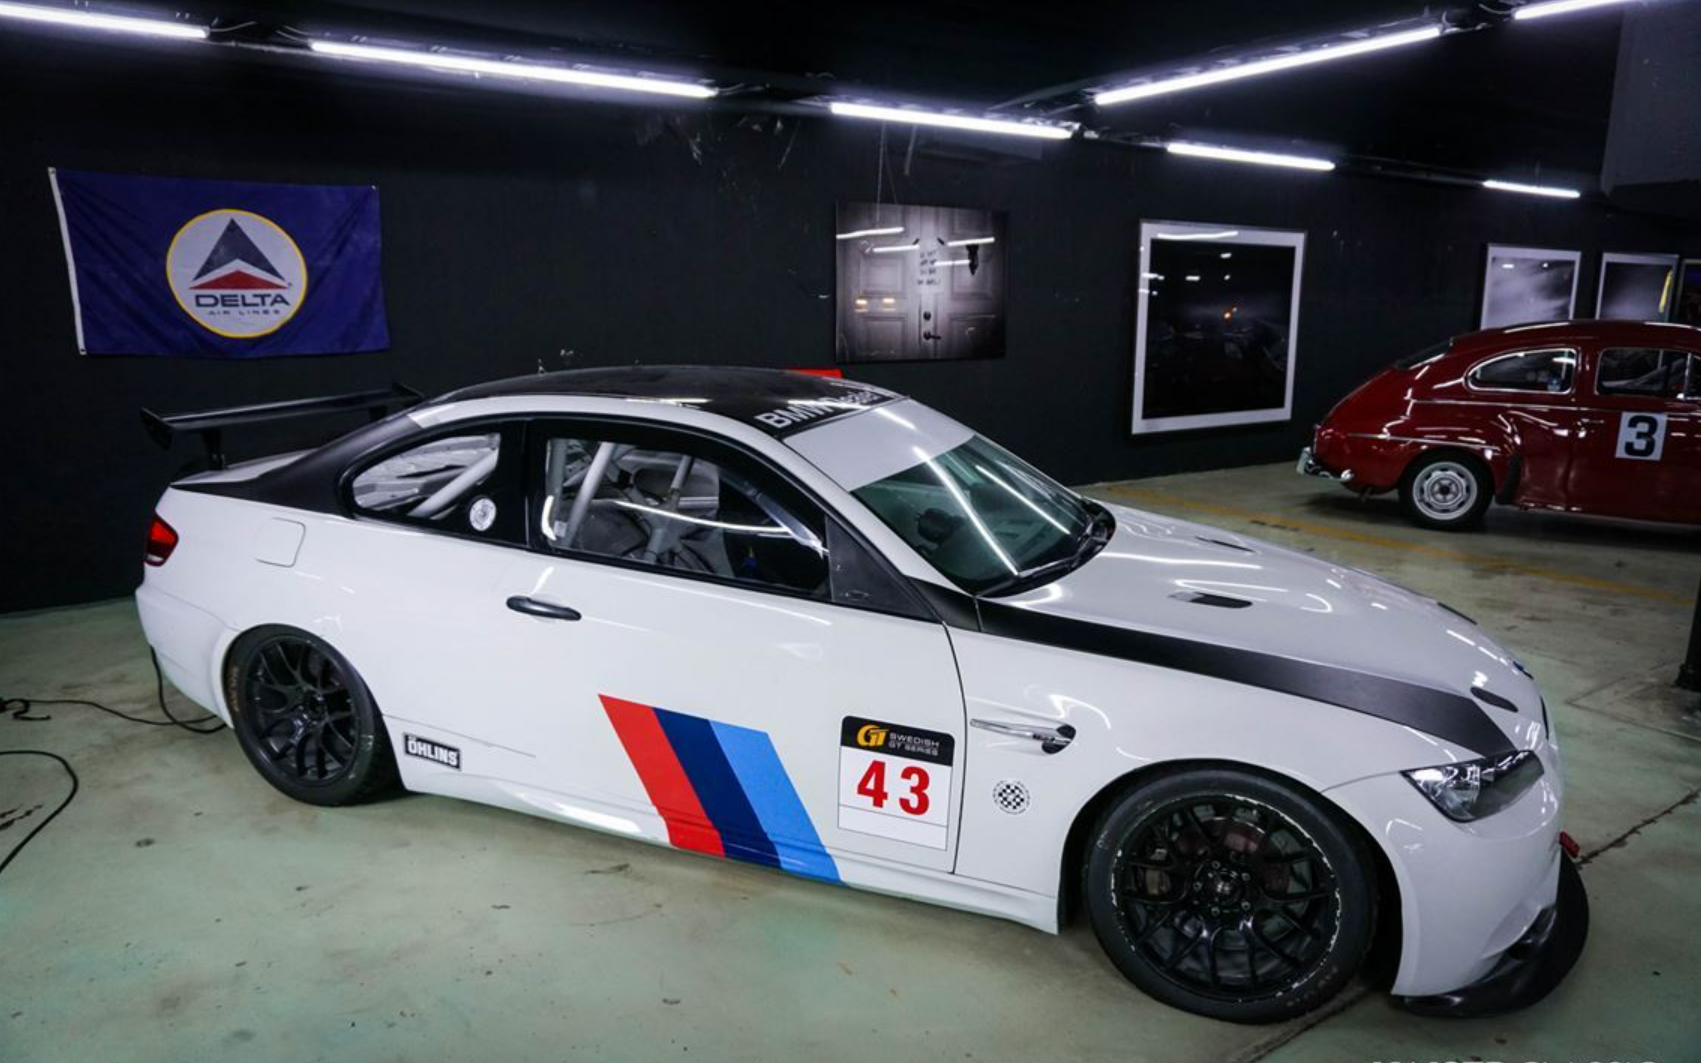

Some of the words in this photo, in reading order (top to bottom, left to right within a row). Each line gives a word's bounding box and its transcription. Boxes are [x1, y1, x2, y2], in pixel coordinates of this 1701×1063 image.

[195, 293, 290, 308] DELTA
[1624, 414, 1658, 458] 3
[408, 736, 458, 767] ÖHLINS
[888, 740, 902, 749] GT
[904, 744, 939, 756] SERIES
[889, 732, 940, 748] SWEDISH
[857, 759, 930, 816] 43
